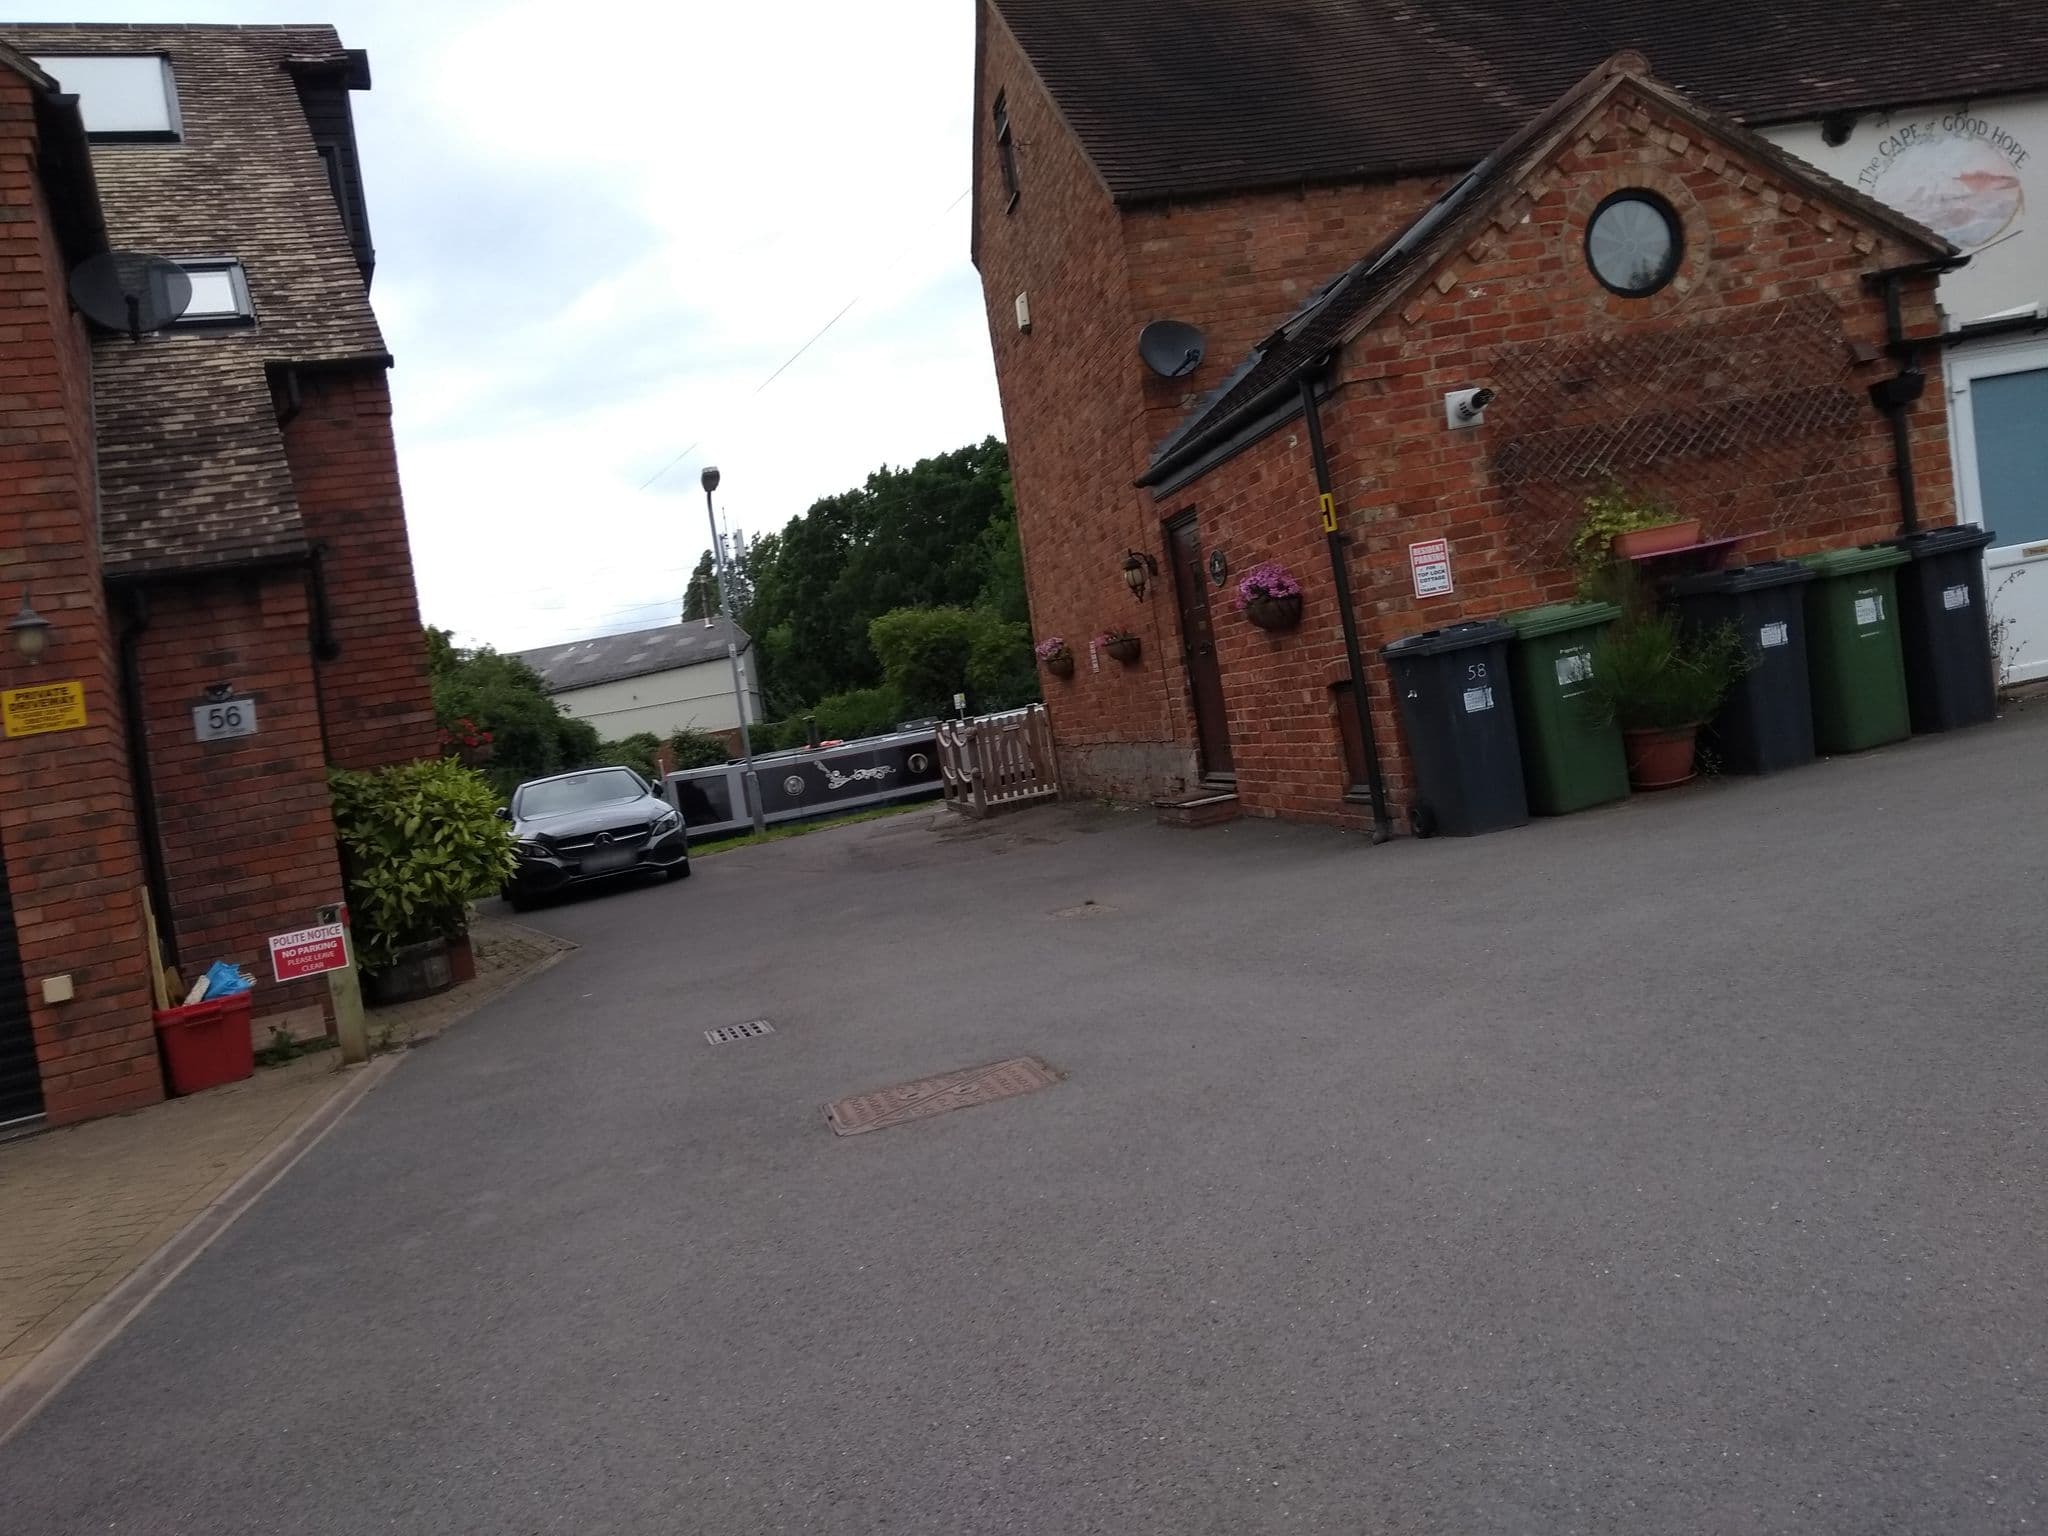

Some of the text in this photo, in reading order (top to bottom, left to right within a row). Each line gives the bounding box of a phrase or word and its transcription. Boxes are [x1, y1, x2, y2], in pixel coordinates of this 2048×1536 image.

[1859, 157, 1881, 184] The
[1879, 123, 1917, 156] CAPE
[1942, 115, 1988, 136] GOOD
[1992, 126, 2027, 169] HOPE
[1468, 663, 1486, 681] 58
[8, 694, 76, 711] DRIVEWAY
[15, 687, 69, 701] PRIVATE
[209, 705, 242, 729] 56
[273, 925, 341, 947] POLITE NOTICE
[282, 940, 337, 959] NO PARKING
[288, 951, 335, 966] PLEASE LEAVE
[301, 962, 325, 971] CLEAR
